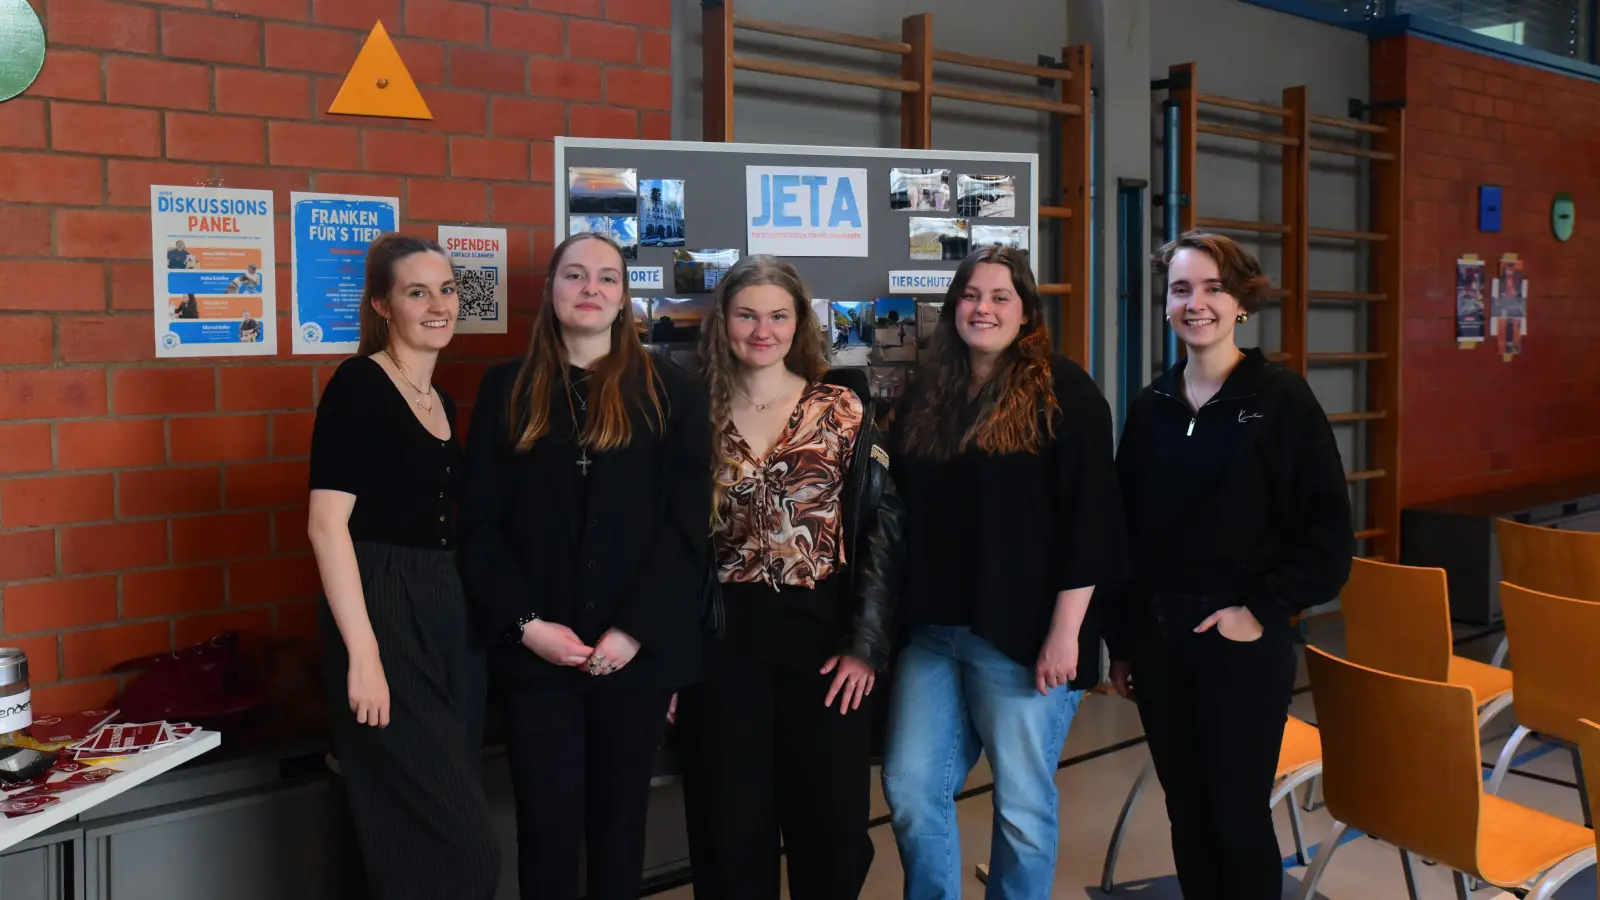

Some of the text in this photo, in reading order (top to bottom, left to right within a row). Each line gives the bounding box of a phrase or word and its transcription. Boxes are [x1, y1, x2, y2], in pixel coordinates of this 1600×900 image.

[158, 196, 268, 216] DISKUSSIONS
[752, 174, 862, 228] JETA
[188, 215, 241, 232] PANEL
[311, 208, 378, 226] FRANKEN
[447, 238, 499, 252] SPENDEN
[891, 276, 952, 287] TIERSCHUTZ
